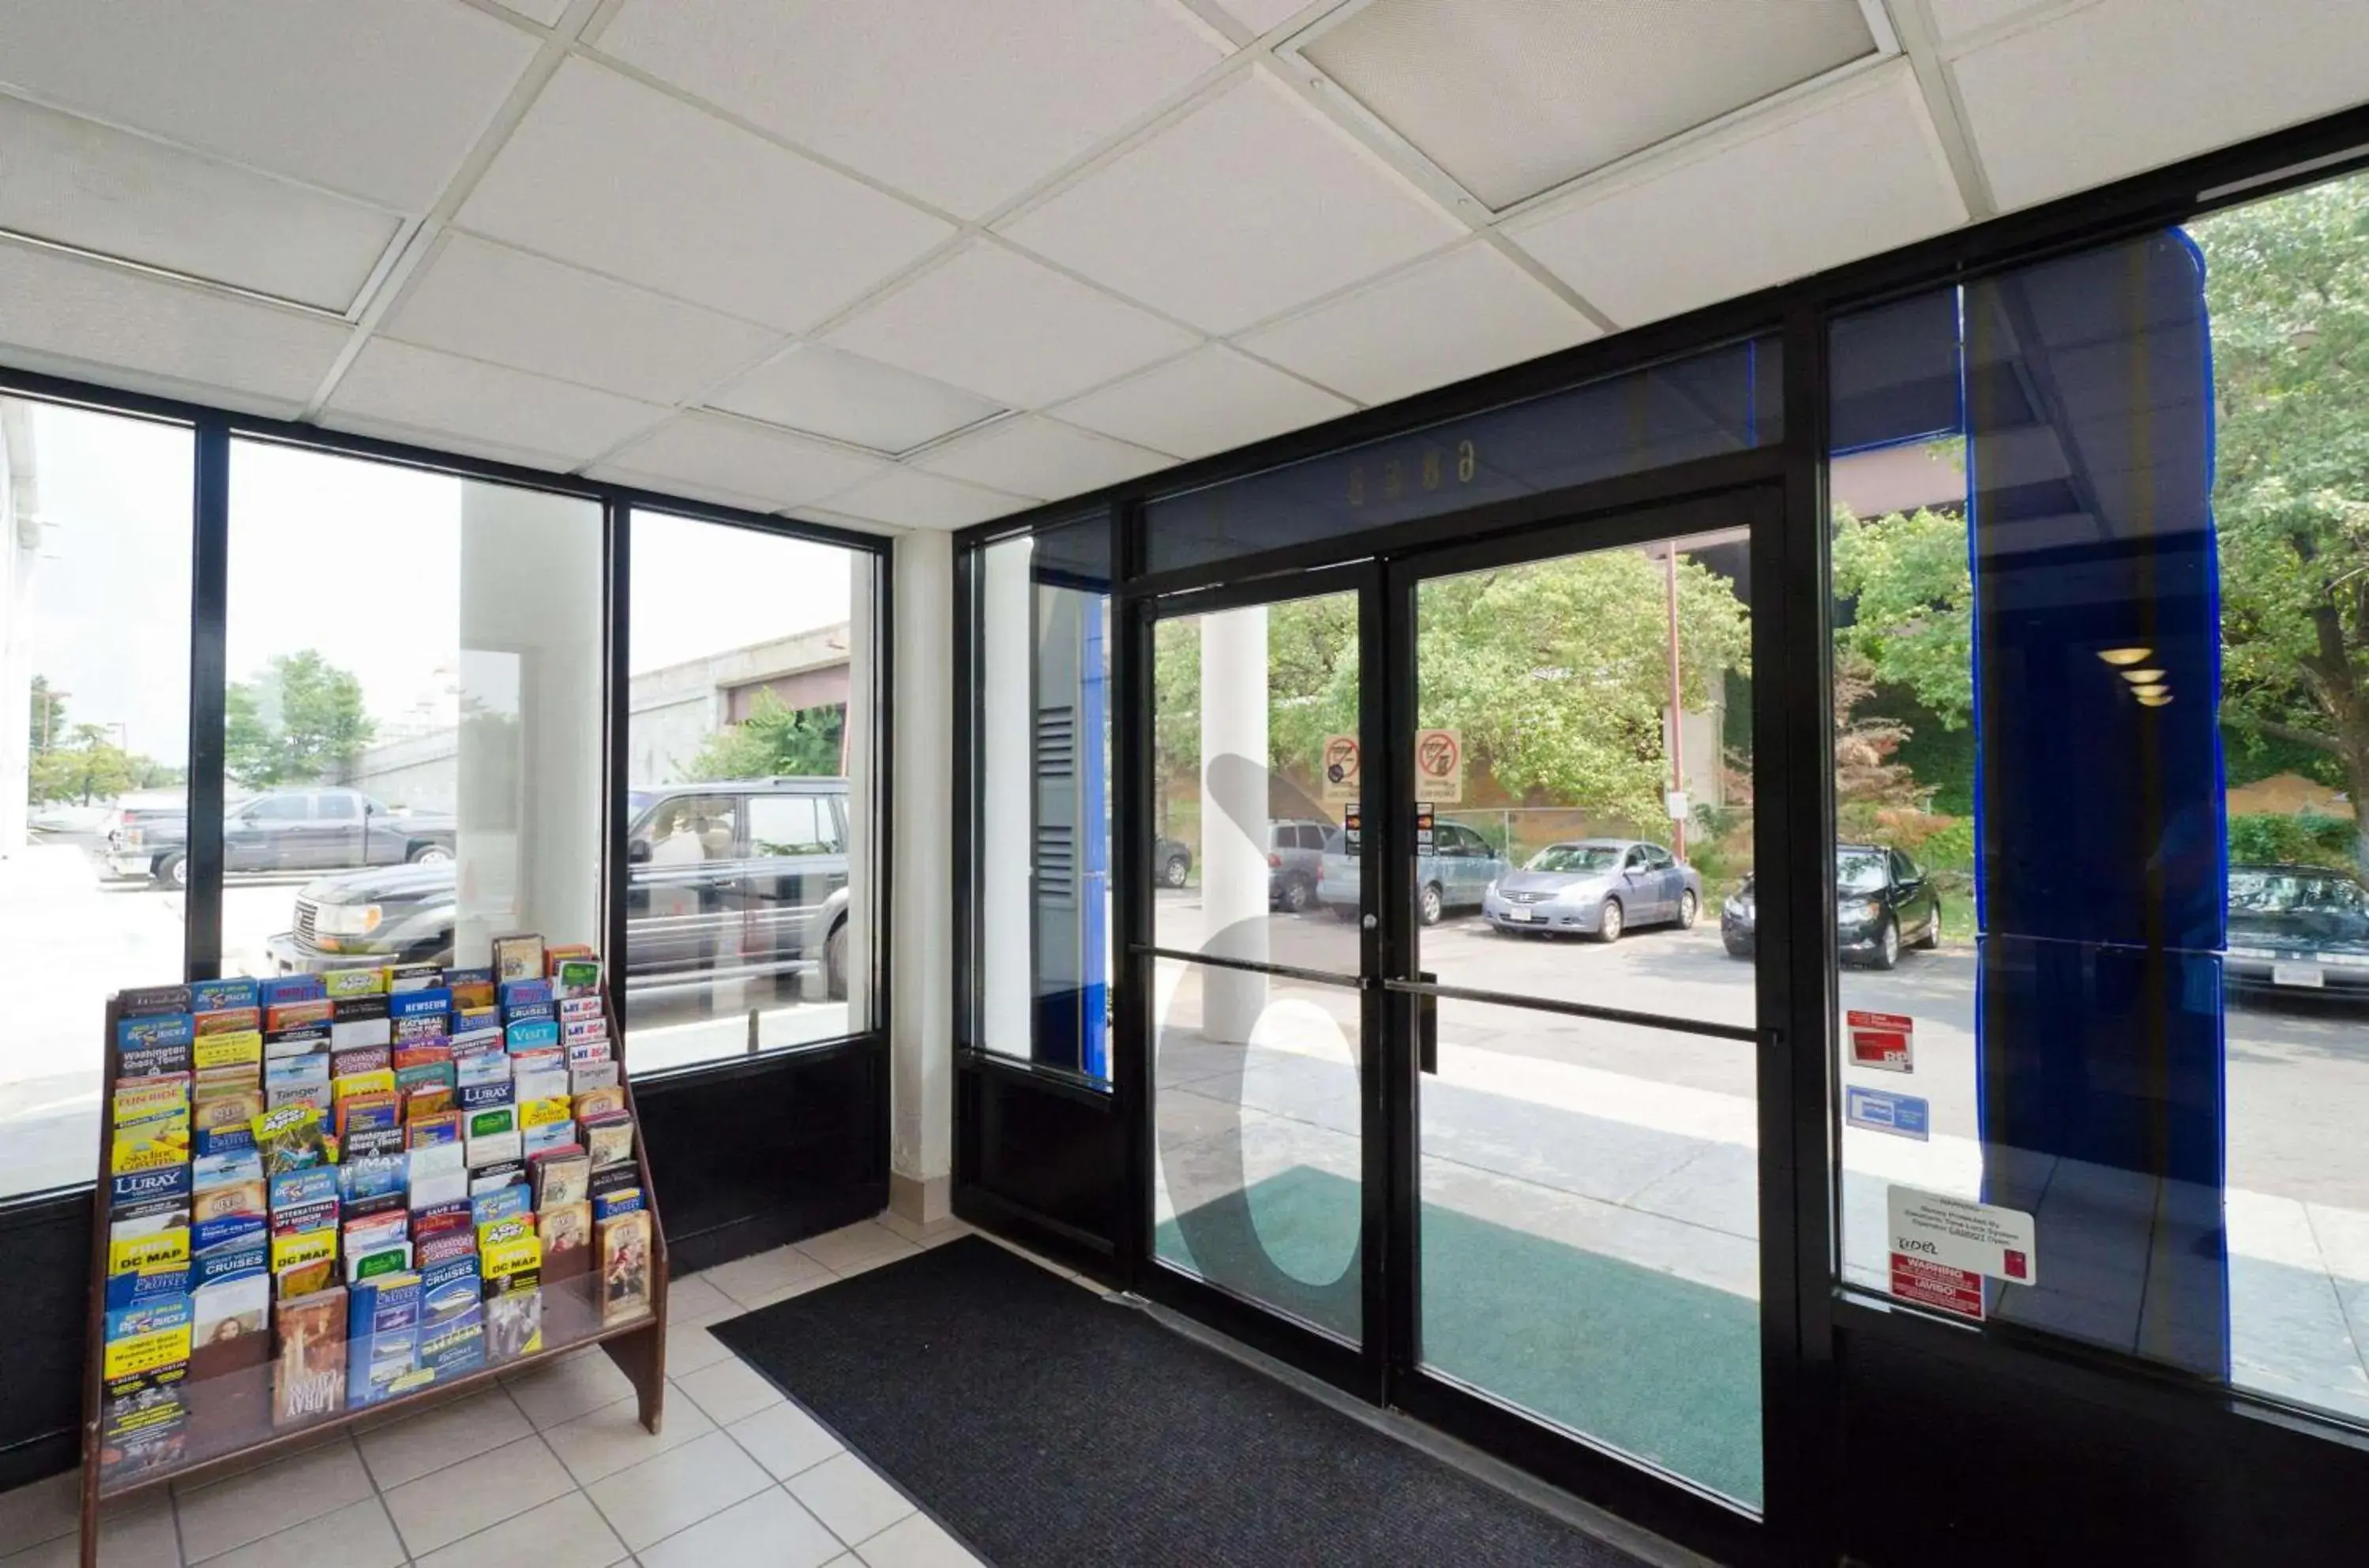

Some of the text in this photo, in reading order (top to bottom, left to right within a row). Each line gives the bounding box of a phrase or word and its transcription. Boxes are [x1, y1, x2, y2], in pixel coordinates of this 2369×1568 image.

[405, 999, 447, 1013] NEWSEUM
[124, 1045, 186, 1060] Washington
[124, 1054, 186, 1071] Ghost Tours
[276, 1086, 321, 1101] Tanger
[464, 1085, 510, 1102] LURAY
[350, 1127, 404, 1142] Washington
[126, 1147, 174, 1162] Skyline
[358, 1155, 404, 1171] IMAX
[115, 1171, 181, 1195] LURAY
[275, 1202, 333, 1220] INTERNATIONAL
[120, 1248, 182, 1270] DC MAP
[206, 1255, 264, 1275] CRUISES
[277, 1255, 297, 1268] DC
[299, 1247, 331, 1262] MAP
[492, 1255, 538, 1274] DC MAP
[426, 1264, 473, 1287] CRUISES
[1907, 1256, 1964, 1279] WARNING
